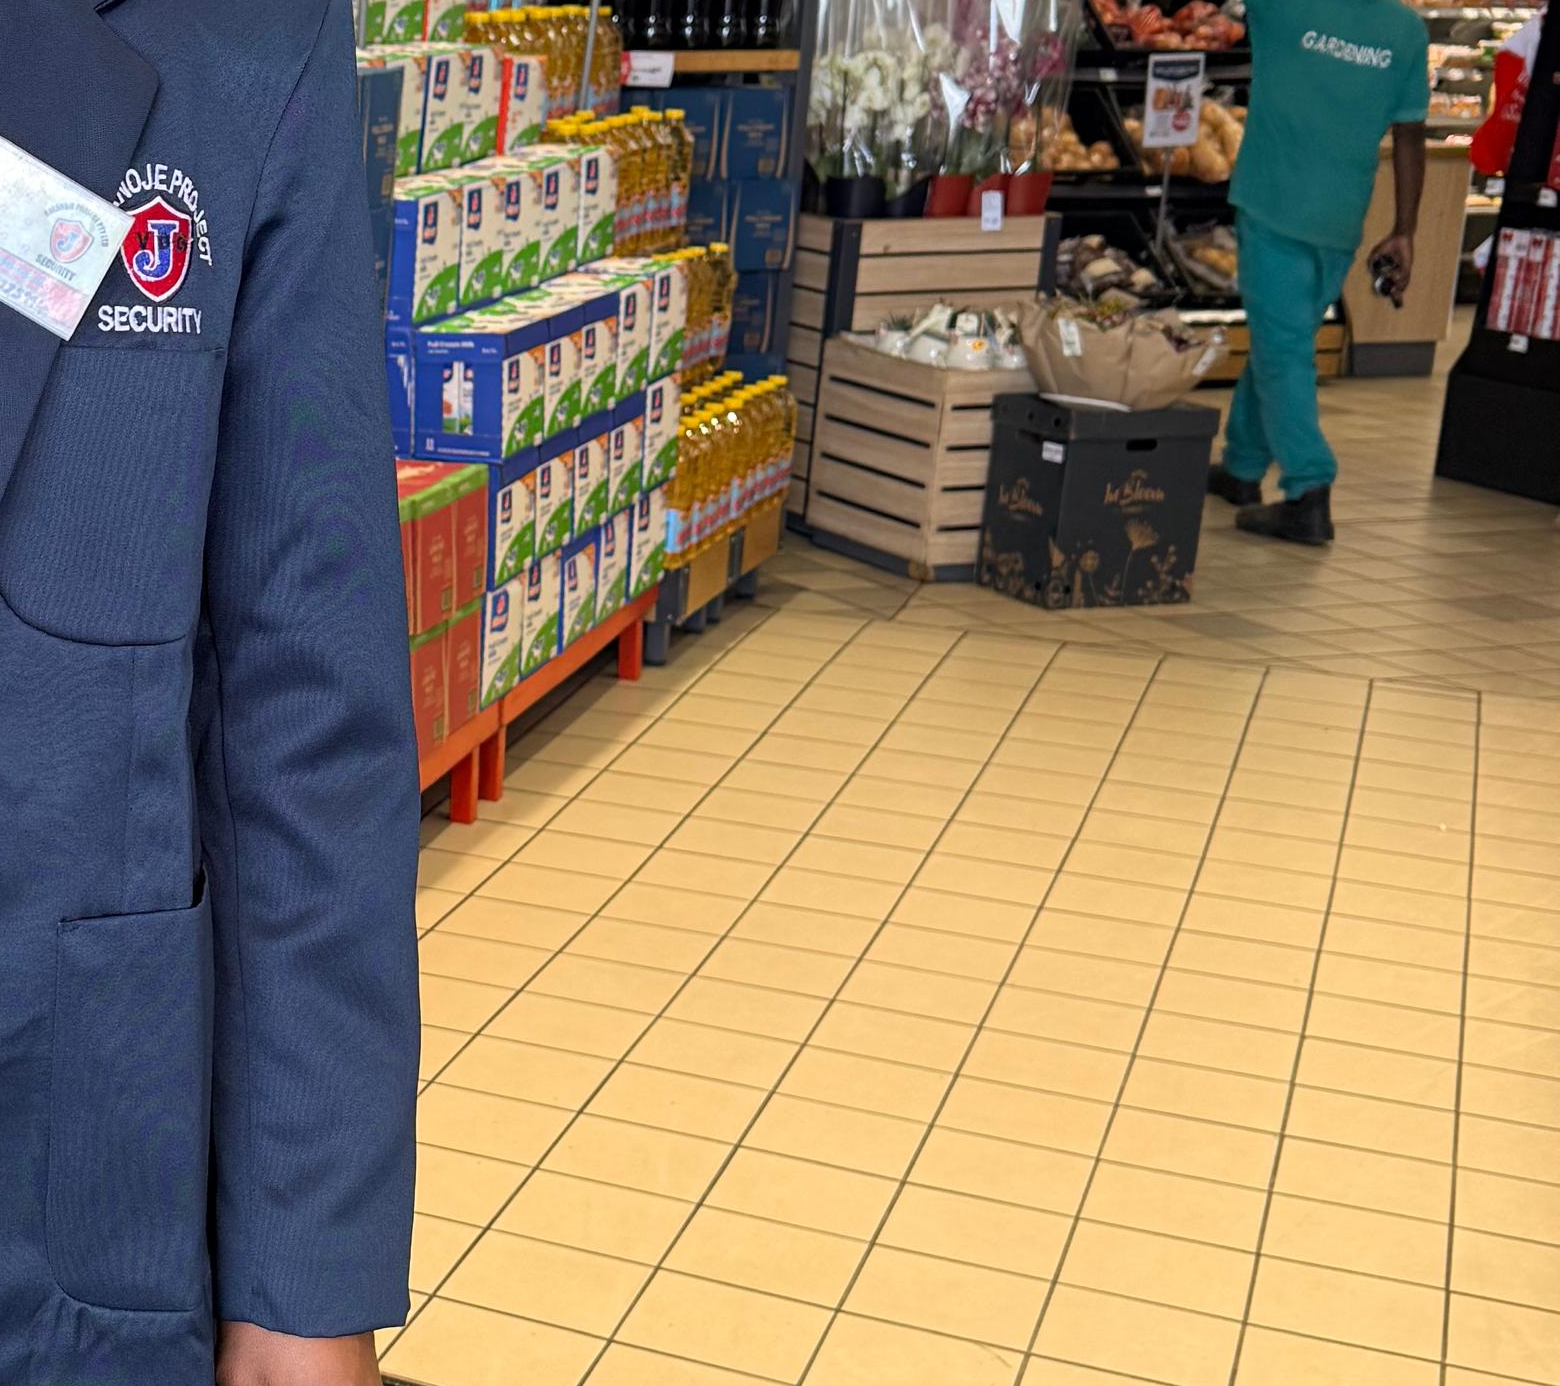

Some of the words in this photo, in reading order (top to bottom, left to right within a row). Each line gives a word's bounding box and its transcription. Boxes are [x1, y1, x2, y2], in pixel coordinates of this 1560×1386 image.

[1302, 30, 1392, 68] GARDENING
[168, 168, 213, 266] PROJECT
[98, 305, 202, 335] SECURITY
